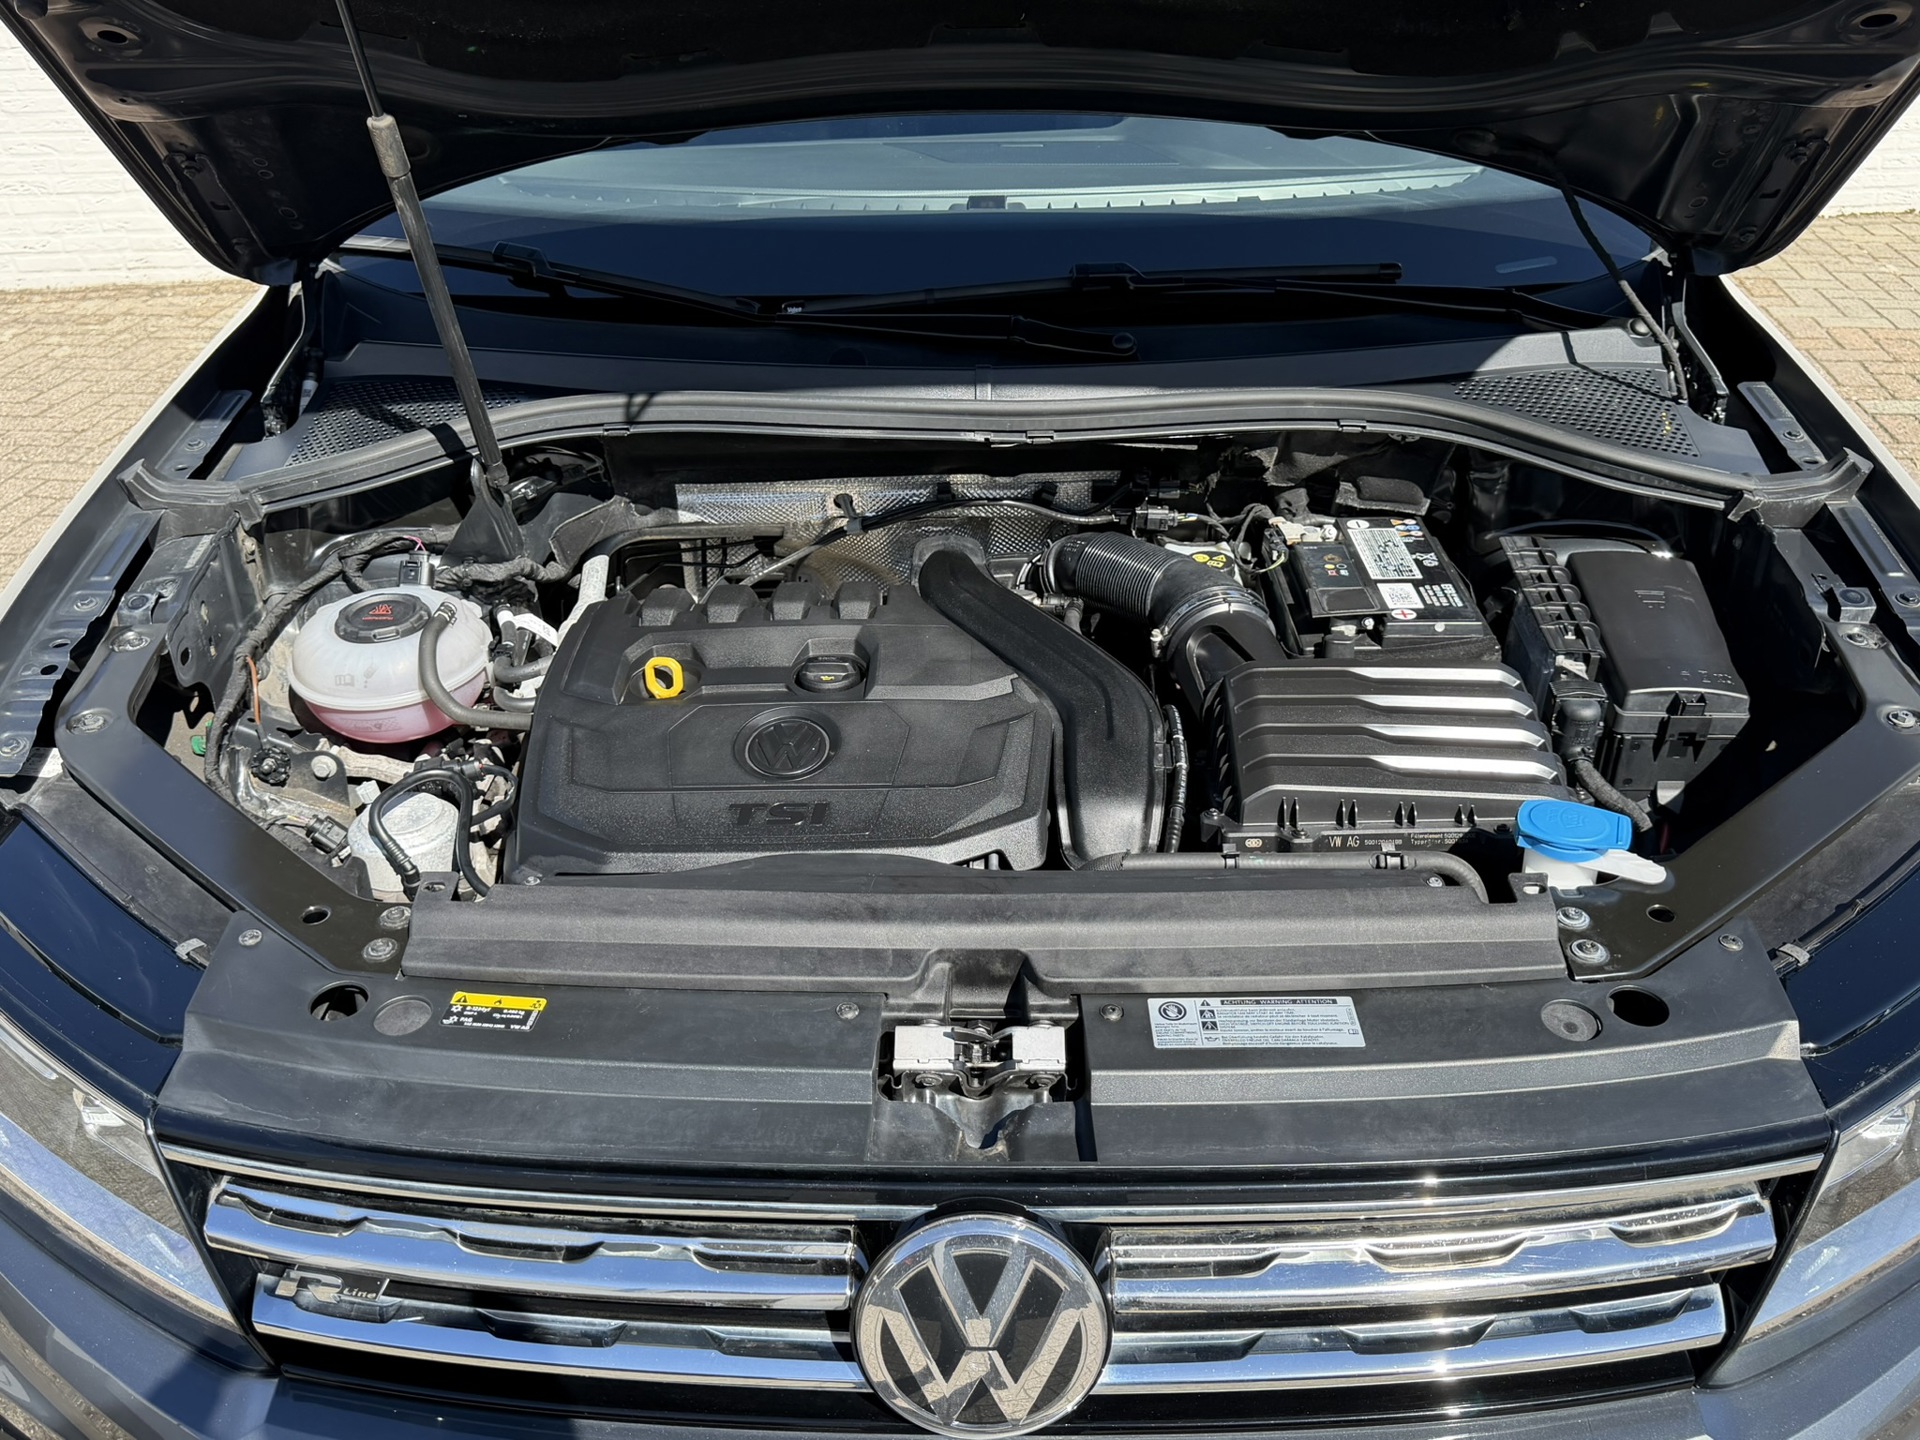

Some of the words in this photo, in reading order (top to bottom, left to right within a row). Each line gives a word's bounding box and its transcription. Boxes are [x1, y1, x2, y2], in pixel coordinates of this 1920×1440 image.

[728, 801, 831, 826] TSI
[1328, 836, 1343, 847] VW
[1346, 836, 1360, 847] AG
[275, 1269, 344, 1304] R
[343, 1287, 377, 1299] Line
